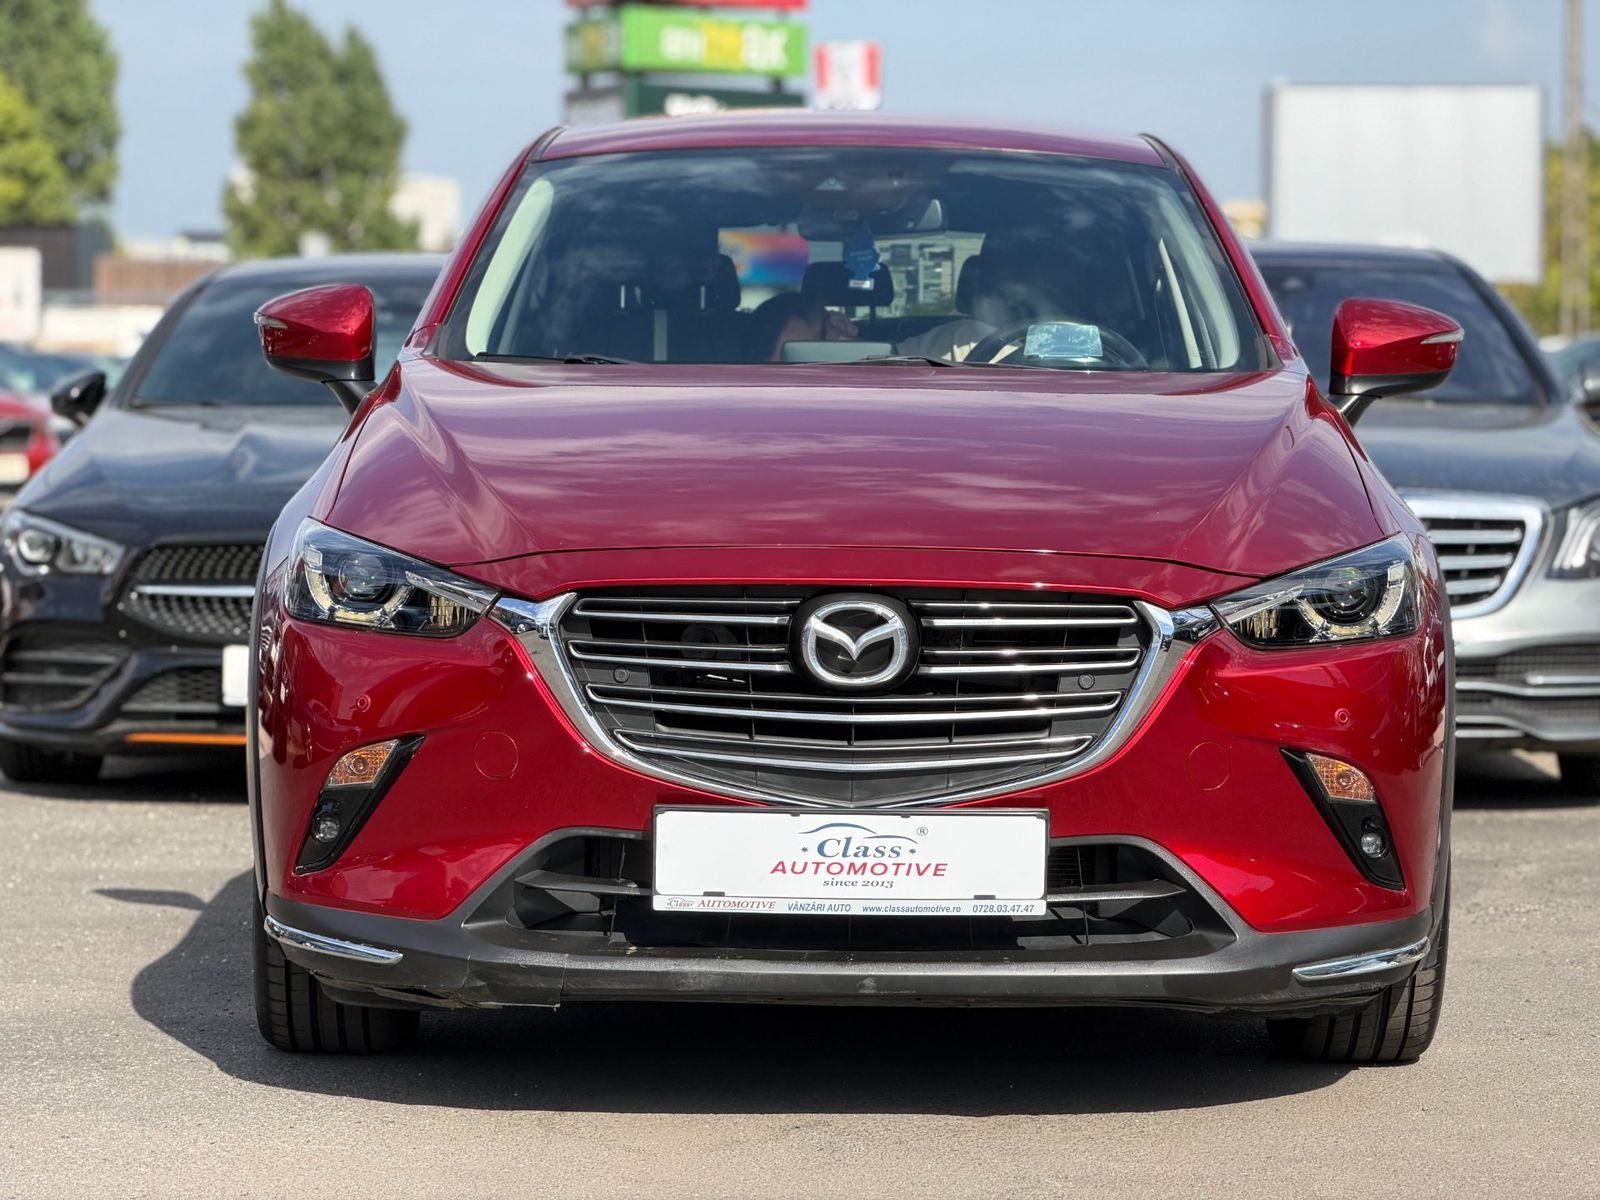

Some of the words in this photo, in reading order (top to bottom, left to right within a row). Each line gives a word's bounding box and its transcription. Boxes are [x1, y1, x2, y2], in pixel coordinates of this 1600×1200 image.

[817, 836, 902, 859] Class
[770, 861, 948, 877] AUTOMOTIVE
[823, 877, 859, 887] since
[861, 880, 894, 889] 2013
[697, 899, 776, 910] AUTOMOTIVE
[827, 903, 851, 912] AUTO
[862, 902, 961, 913] www.classautomotive.ro
[972, 904, 1034, 914] 0728.03.47.47
